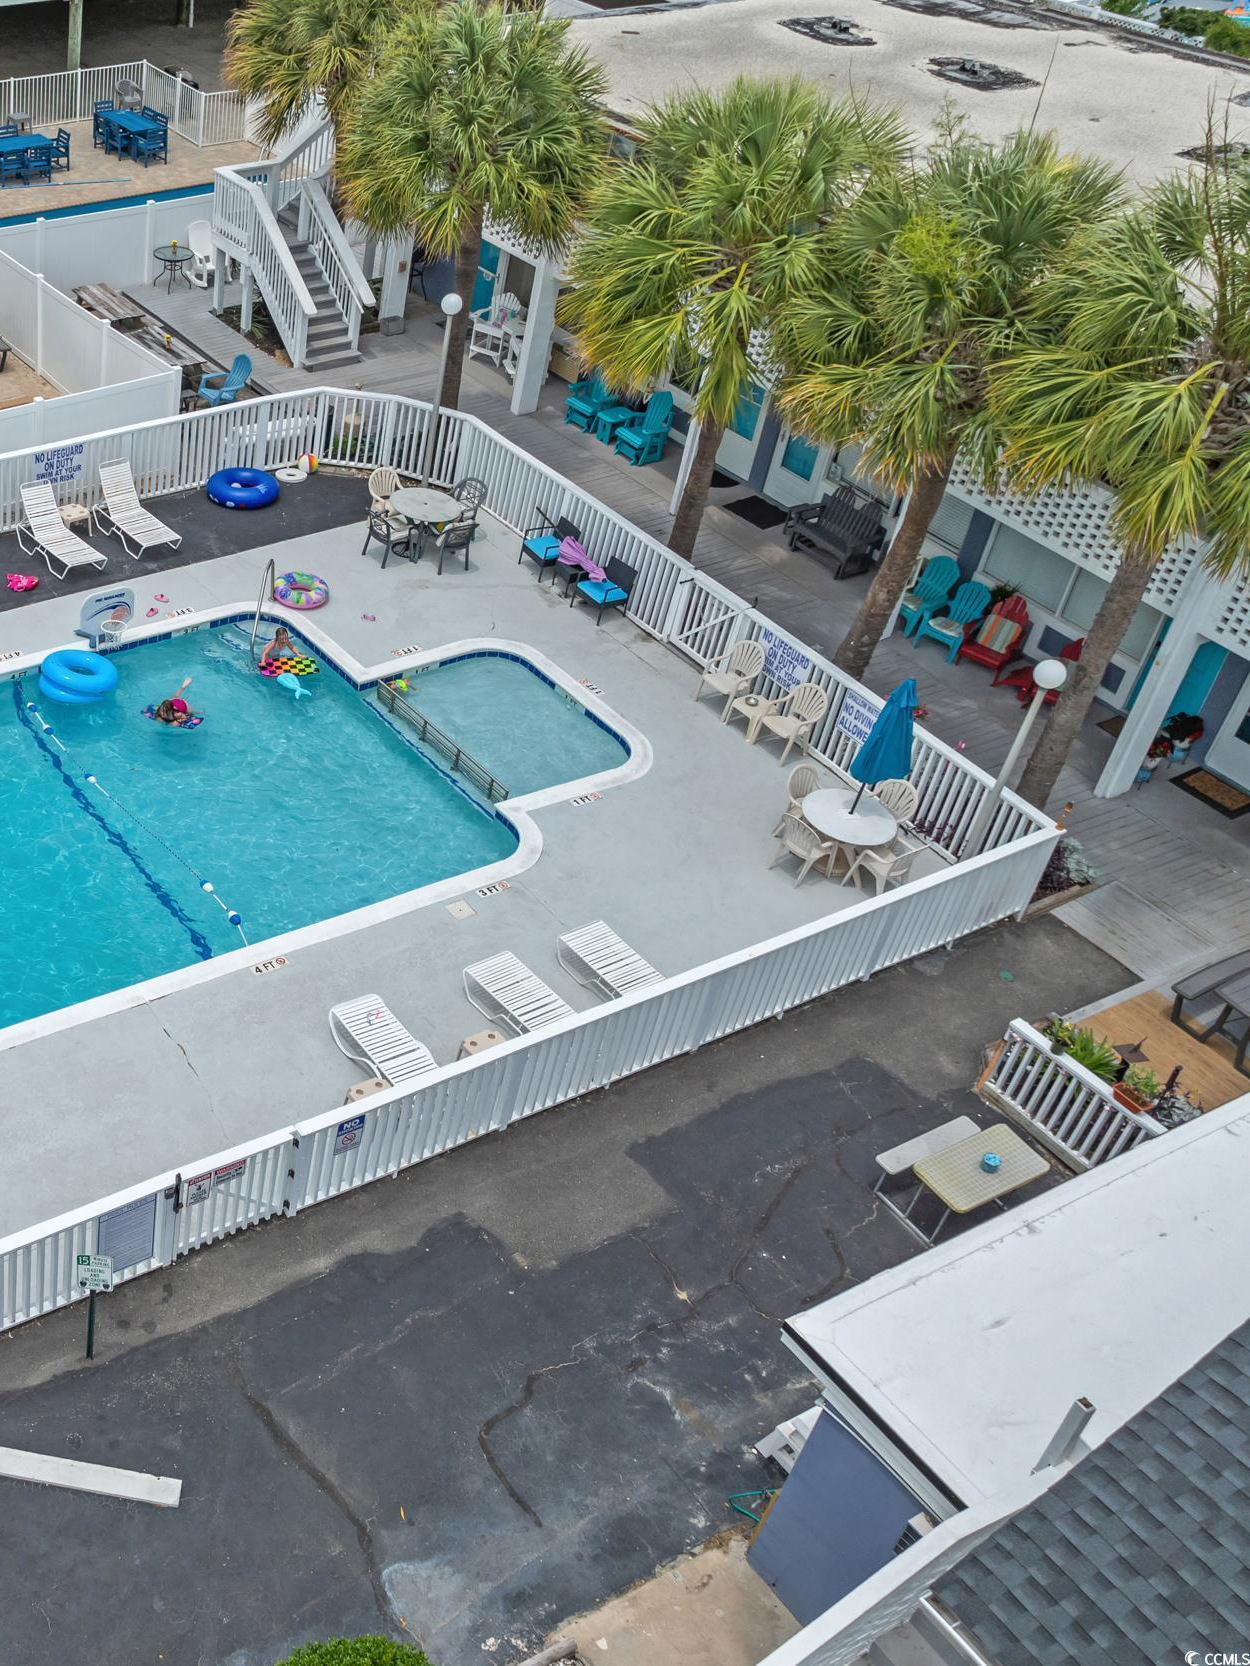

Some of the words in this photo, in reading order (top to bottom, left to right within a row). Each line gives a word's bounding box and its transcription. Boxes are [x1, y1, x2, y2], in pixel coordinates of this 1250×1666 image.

[35, 452, 45, 464] NO
[46, 444, 84, 461] LIFEGUARD
[36, 471, 54, 480] SWIM
[64, 464, 82, 474] YOUR
[44, 461, 54, 471] ON
[55, 457, 74, 469] DUTY
[59, 472, 75, 482] RISK
[762, 628, 774, 644] NO
[773, 636, 810, 670] LIFEGUARD
[768, 646, 779, 661] ON
[778, 652, 798, 675] DUTY
[762, 662, 776, 679] OWN
[775, 673, 792, 690] RISK
[774, 663, 784, 675] AT
[784, 670, 801, 687] YOUR
[844, 702, 855, 717] NO
[854, 709, 874, 731] DIVIN
[839, 715, 869, 744] ALLOWE
[580, 795, 592, 803] FT
[478, 889, 488, 897] 3
[486, 885, 499, 894] FT
[262, 961, 275, 971] FT
[343, 1118, 360, 1131] NO
[78, 1256, 89, 1265] 15
